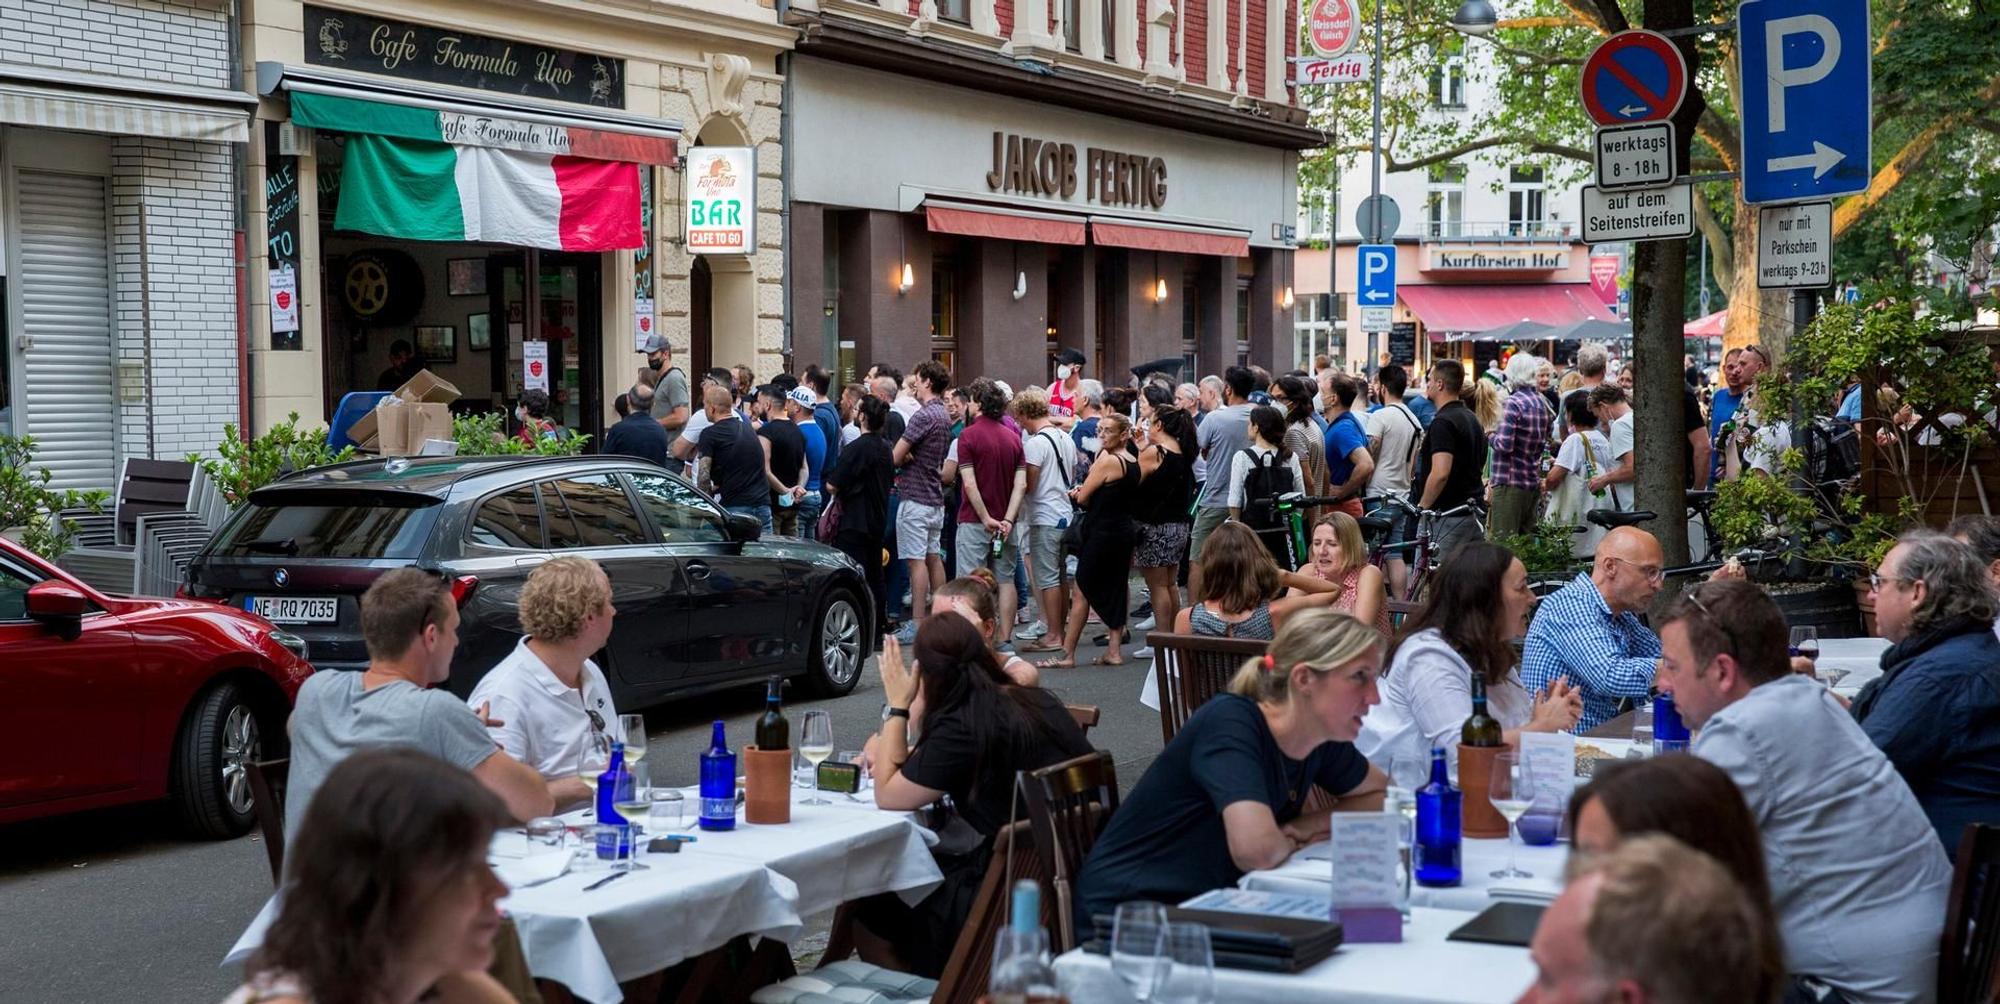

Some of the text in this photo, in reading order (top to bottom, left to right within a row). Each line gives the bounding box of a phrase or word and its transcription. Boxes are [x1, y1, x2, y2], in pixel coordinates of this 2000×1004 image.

[370, 24, 575, 86] Cafe Formula Uno
[1305, 59, 1361, 83] Fertig
[1765, 14, 1841, 133] P
[434, 112, 574, 147] Cafe Formula Uno
[1604, 136, 1666, 153] werktags
[697, 174, 737, 188] Formula
[986, 132, 1167, 208] JAKOB FERTIG
[266, 164, 294, 199] ALLE
[1608, 191, 1666, 210] auf dem
[691, 199, 741, 226] BAR
[1590, 210, 1685, 232] Seitenstreifen
[1779, 214, 1811, 232] nur mit
[269, 231, 293, 260] TO
[691, 232, 741, 244] CAFE TO GO
[1771, 238, 1817, 255] Parkschein
[1365, 252, 1388, 286] P
[1440, 253, 1561, 268] Kurfürsten Hof
[1763, 264, 1798, 280] werktags
[254, 600, 335, 618] NE RQ 7035
